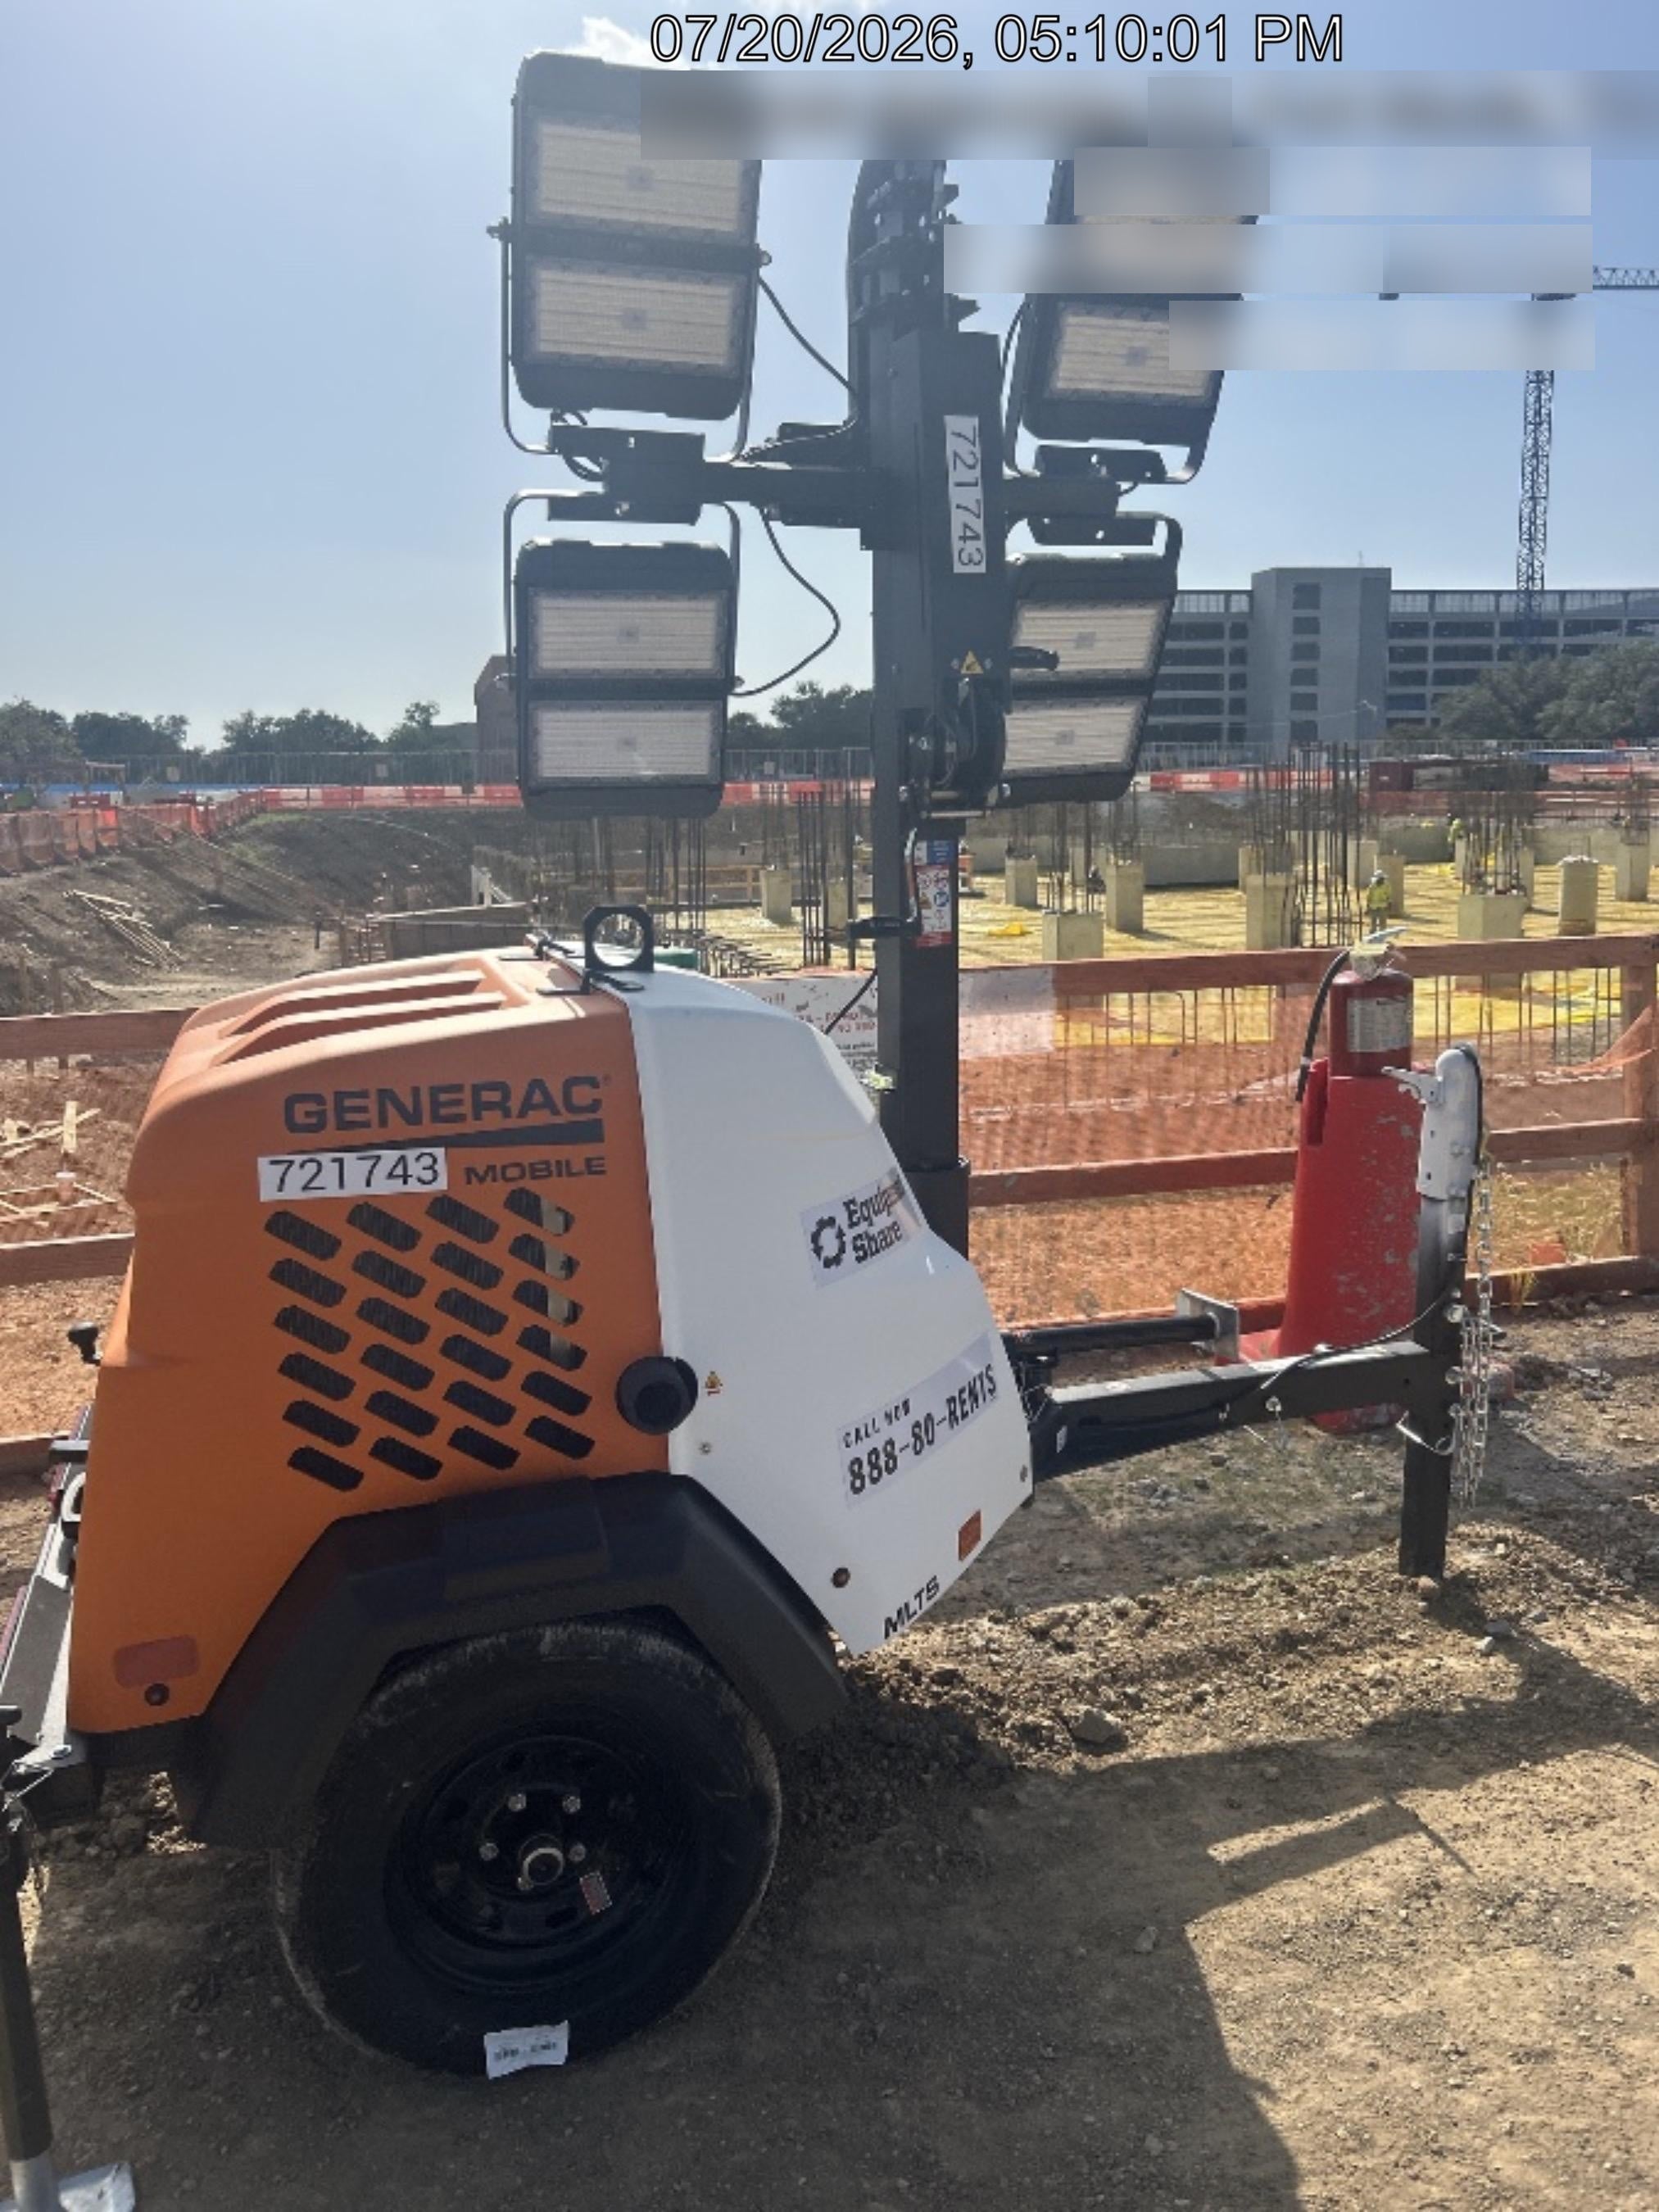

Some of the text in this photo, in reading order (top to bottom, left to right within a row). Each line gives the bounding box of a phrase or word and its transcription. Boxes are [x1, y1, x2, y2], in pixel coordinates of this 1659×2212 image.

[950, 425, 983, 567] 721743
[283, 1075, 604, 1135] GENERAC
[269, 1152, 439, 1193] 721743
[464, 1156, 607, 1185] MOBILE
[852, 1221, 902, 1264] Share
[842, 1416, 881, 1448] CALL
[848, 1363, 997, 1495] 888-80-RENTS
